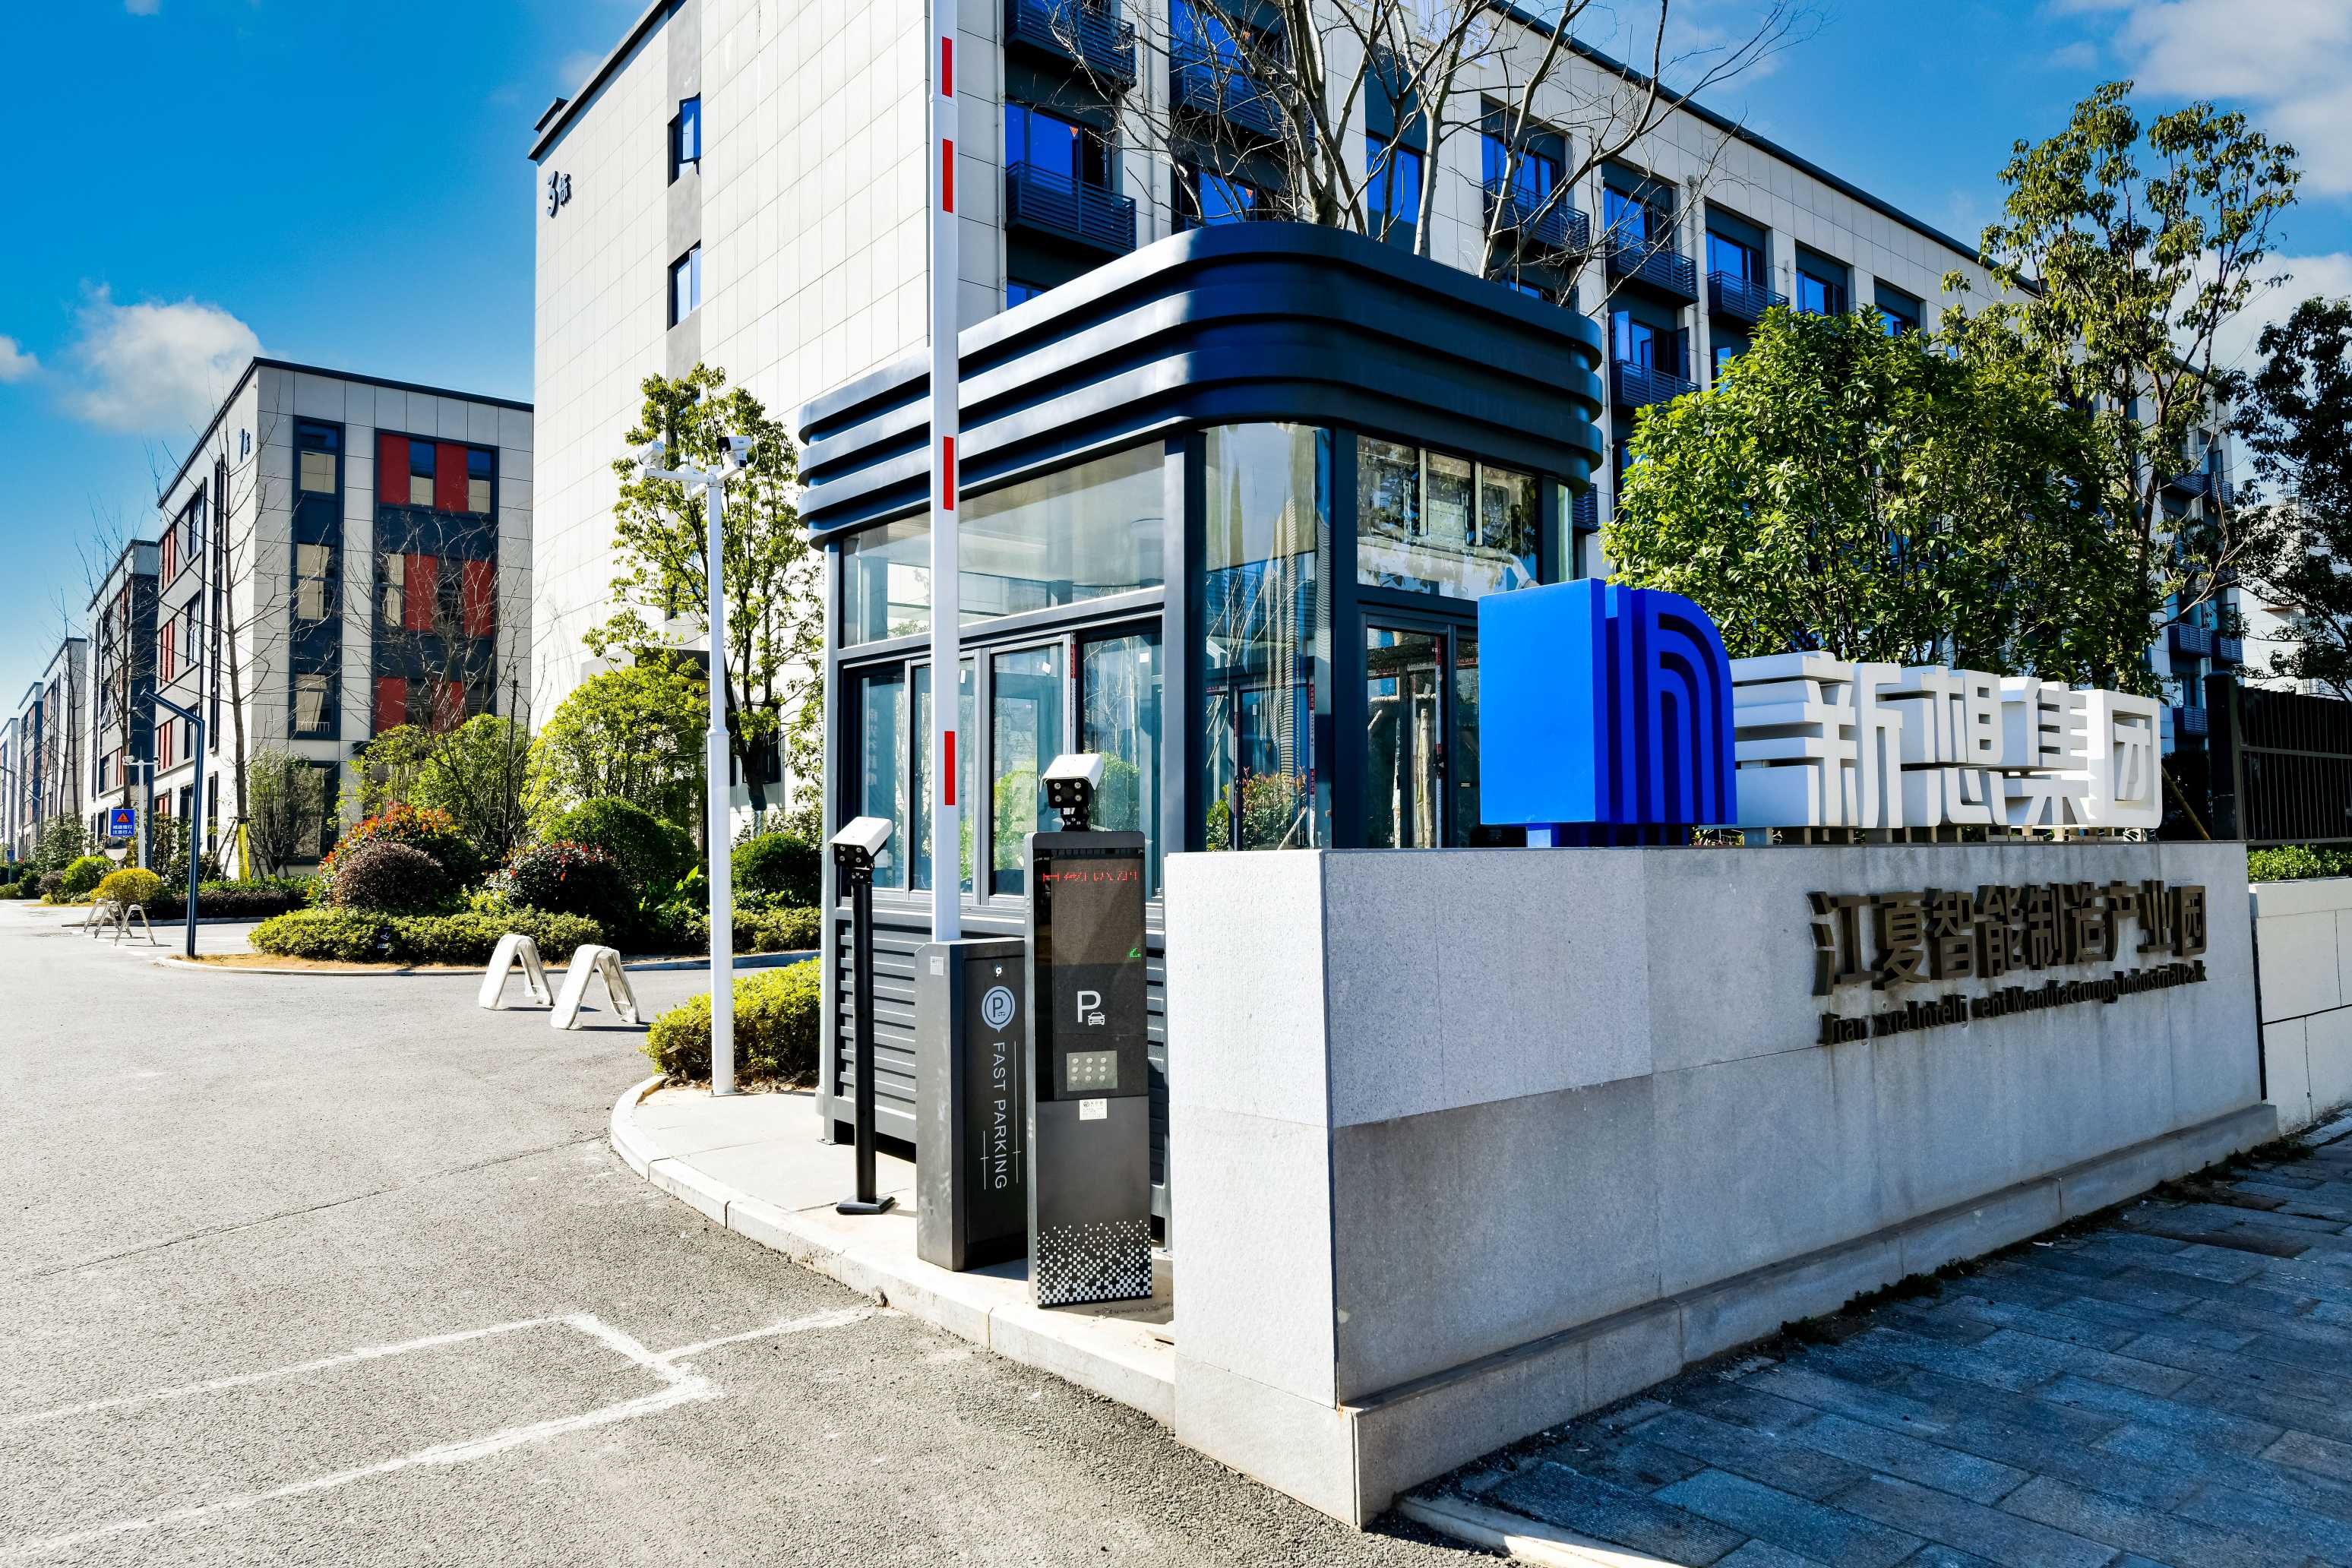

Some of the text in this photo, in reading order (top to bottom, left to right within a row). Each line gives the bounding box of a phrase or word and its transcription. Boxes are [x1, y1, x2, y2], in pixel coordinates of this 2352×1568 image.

[1732, 651, 2163, 830] 新想集团
[1807, 881, 2208, 997] 江夏智能制造产业园
[1077, 990, 1102, 1023] P
[1908, 990, 2006, 1028] Intellient
[993, 1042, 1007, 1190] FAST PARKING
